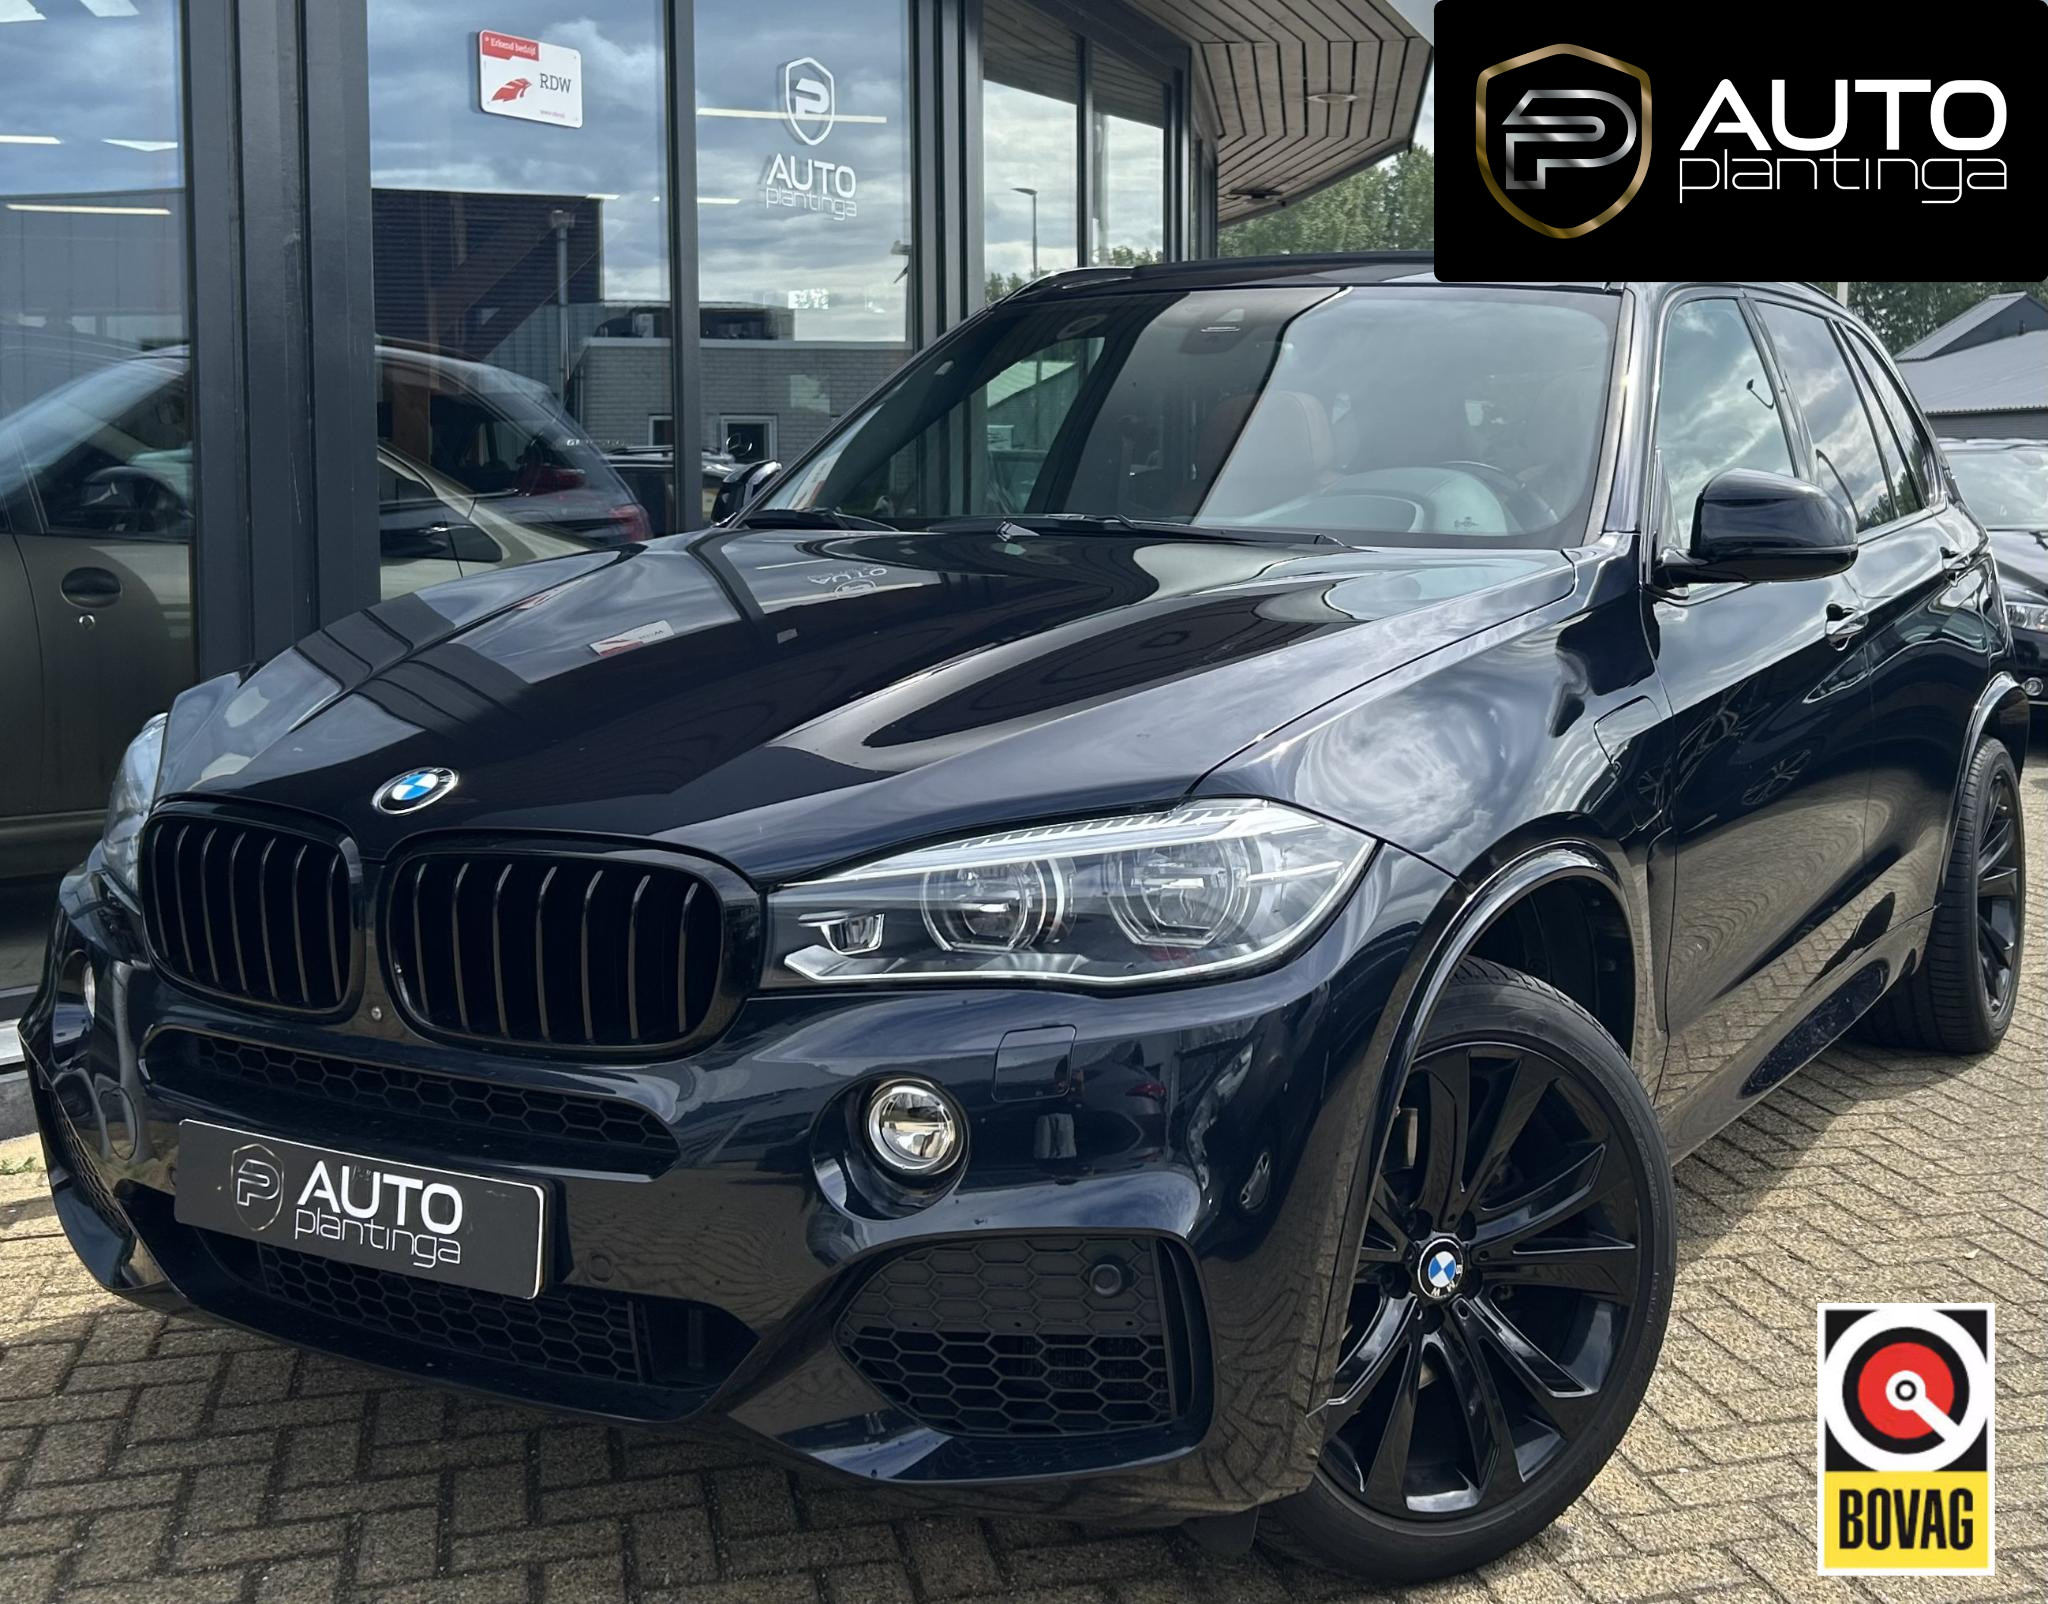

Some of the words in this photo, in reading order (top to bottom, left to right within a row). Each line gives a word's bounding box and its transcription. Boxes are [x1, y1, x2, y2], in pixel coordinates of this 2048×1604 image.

[539, 72, 572, 94] RDW
[766, 153, 856, 199] AUTO
[765, 186, 857, 221] plantinga
[297, 1160, 464, 1235] AUTO
[294, 1207, 462, 1269] plantinga
[1431, 1264, 1463, 1297] BMW
